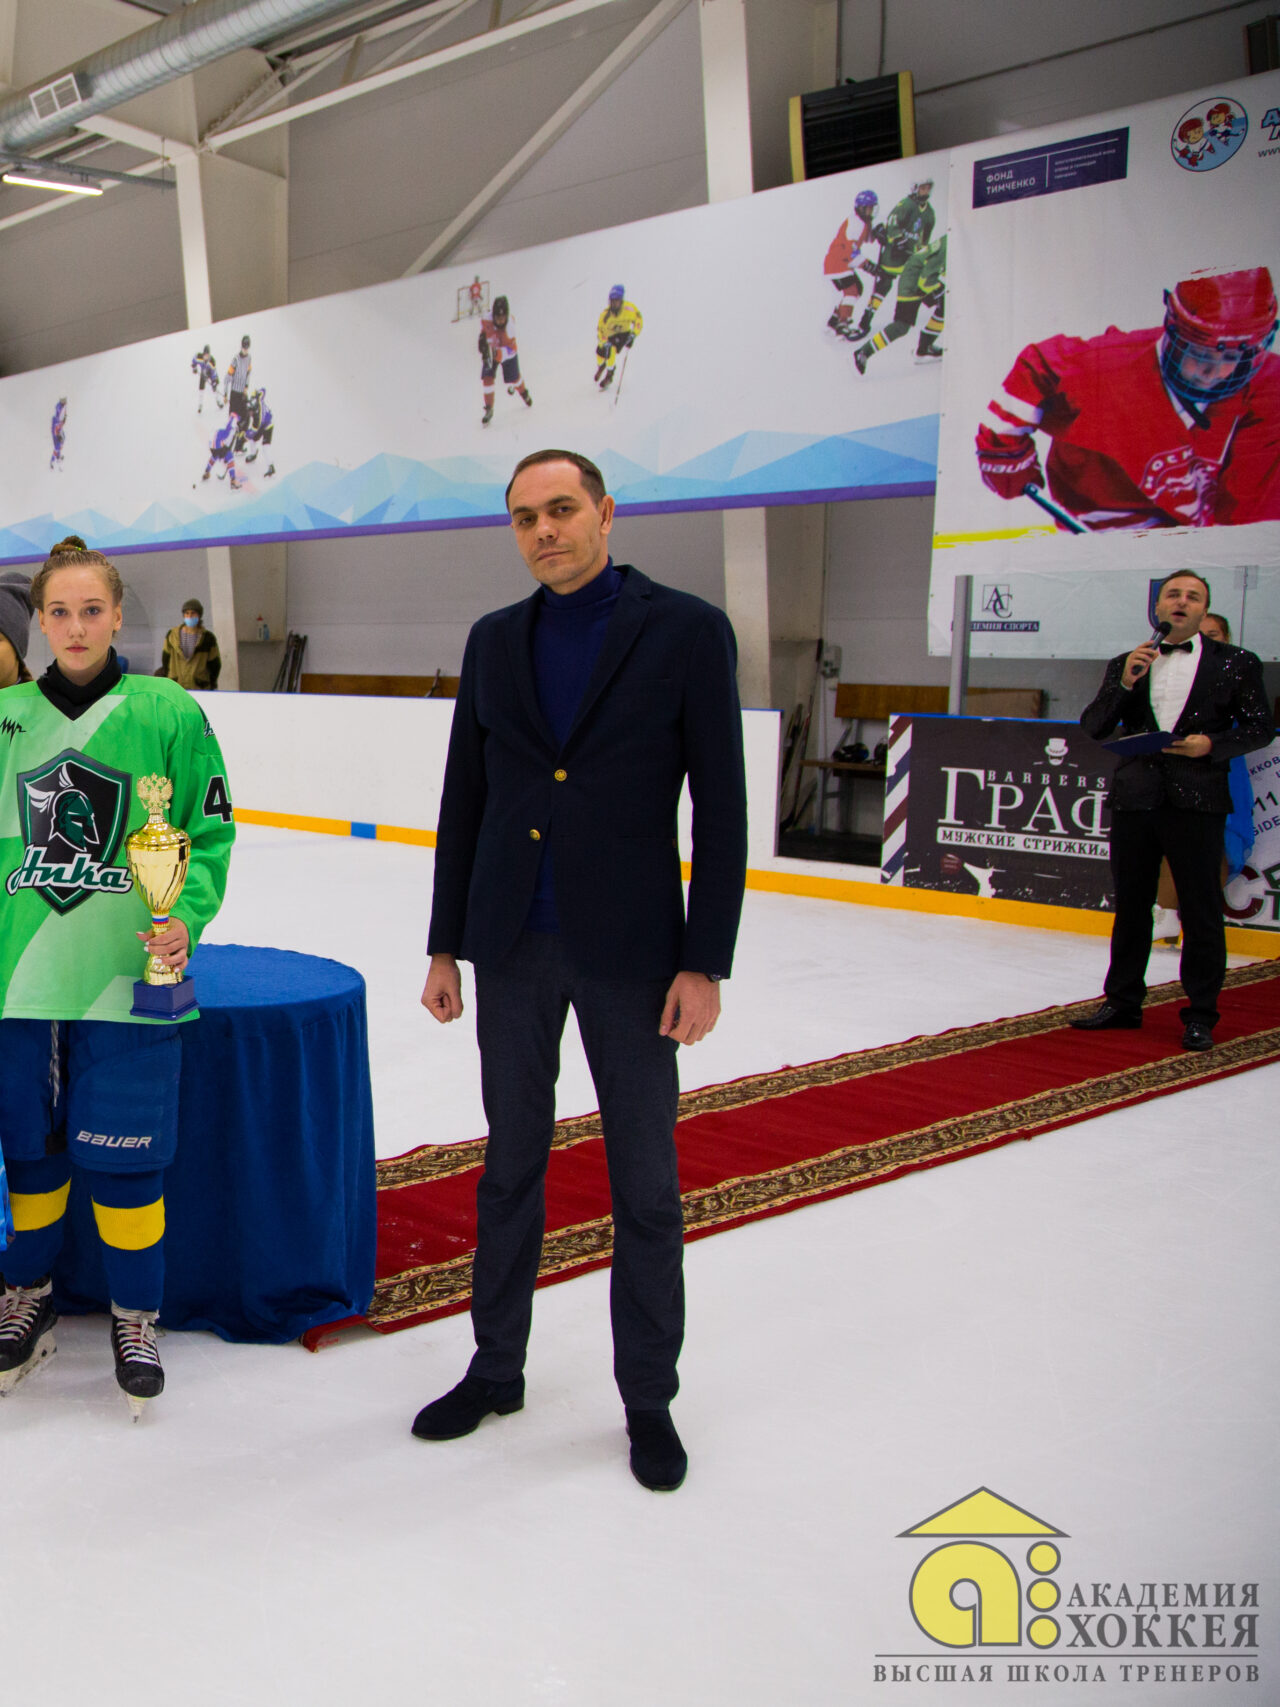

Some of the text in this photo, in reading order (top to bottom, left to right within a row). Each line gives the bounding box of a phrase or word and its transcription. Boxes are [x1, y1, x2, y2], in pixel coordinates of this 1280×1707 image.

[986, 169, 1013, 183] ФОНД
[986, 177, 1036, 195] ТИМЧЕНКО
[203, 775, 232, 823] 4
[942, 830, 1015, 847] МУЖСКИЕ
